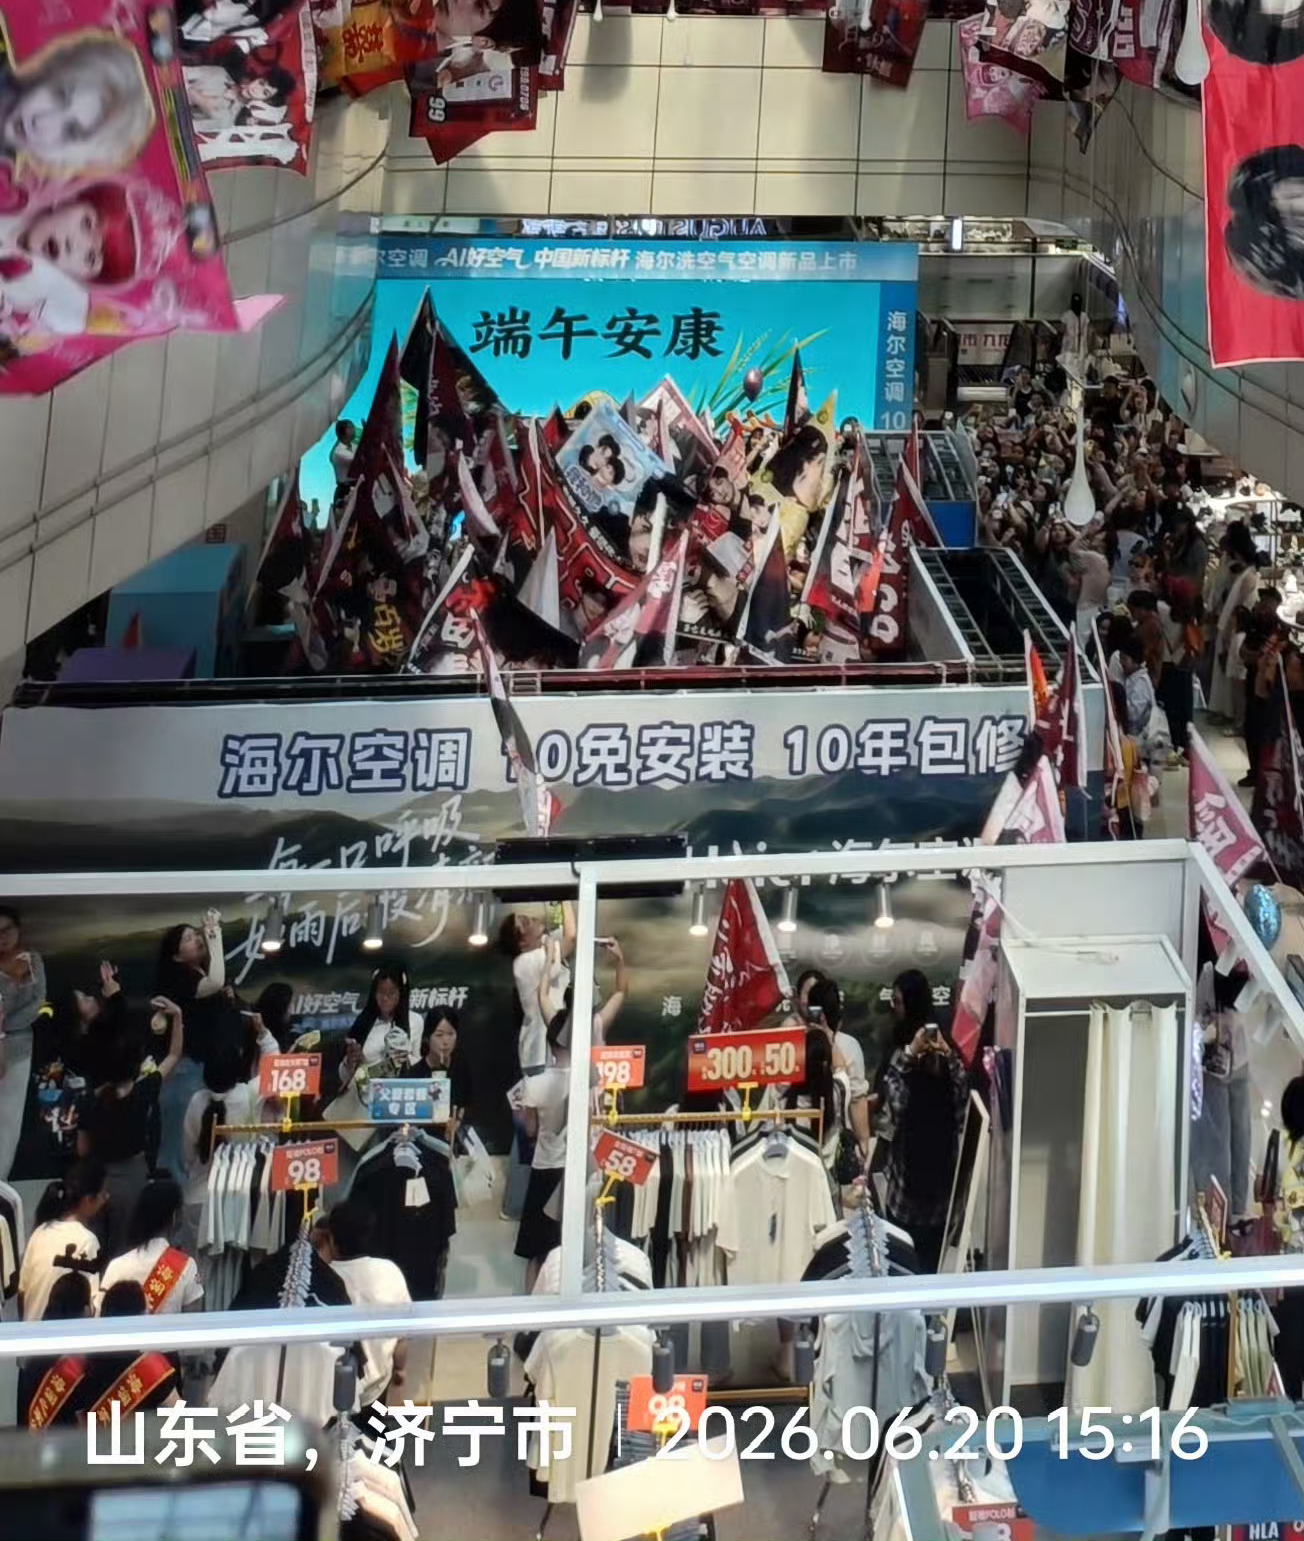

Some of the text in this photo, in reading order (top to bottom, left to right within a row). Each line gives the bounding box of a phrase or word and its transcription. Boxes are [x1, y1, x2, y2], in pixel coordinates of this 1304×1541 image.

[534, 248, 630, 270] 中国新标杆
[634, 251, 858, 273] 海尔洗空气空调新品上市
[471, 305, 726, 360] 端午安康
[883, 310, 907, 404] 海尔空调
[216, 726, 474, 799] 海尔空调
[784, 718, 1031, 777] 10年包修
[409, 987, 470, 1010] 新标杆
[662, 995, 683, 1017] 海
[706, 1042, 796, 1080] 300 50
[270, 1068, 308, 1092] 168
[287, 1158, 321, 1185] 98
[1248, 1521, 1279, 1540] HLA
